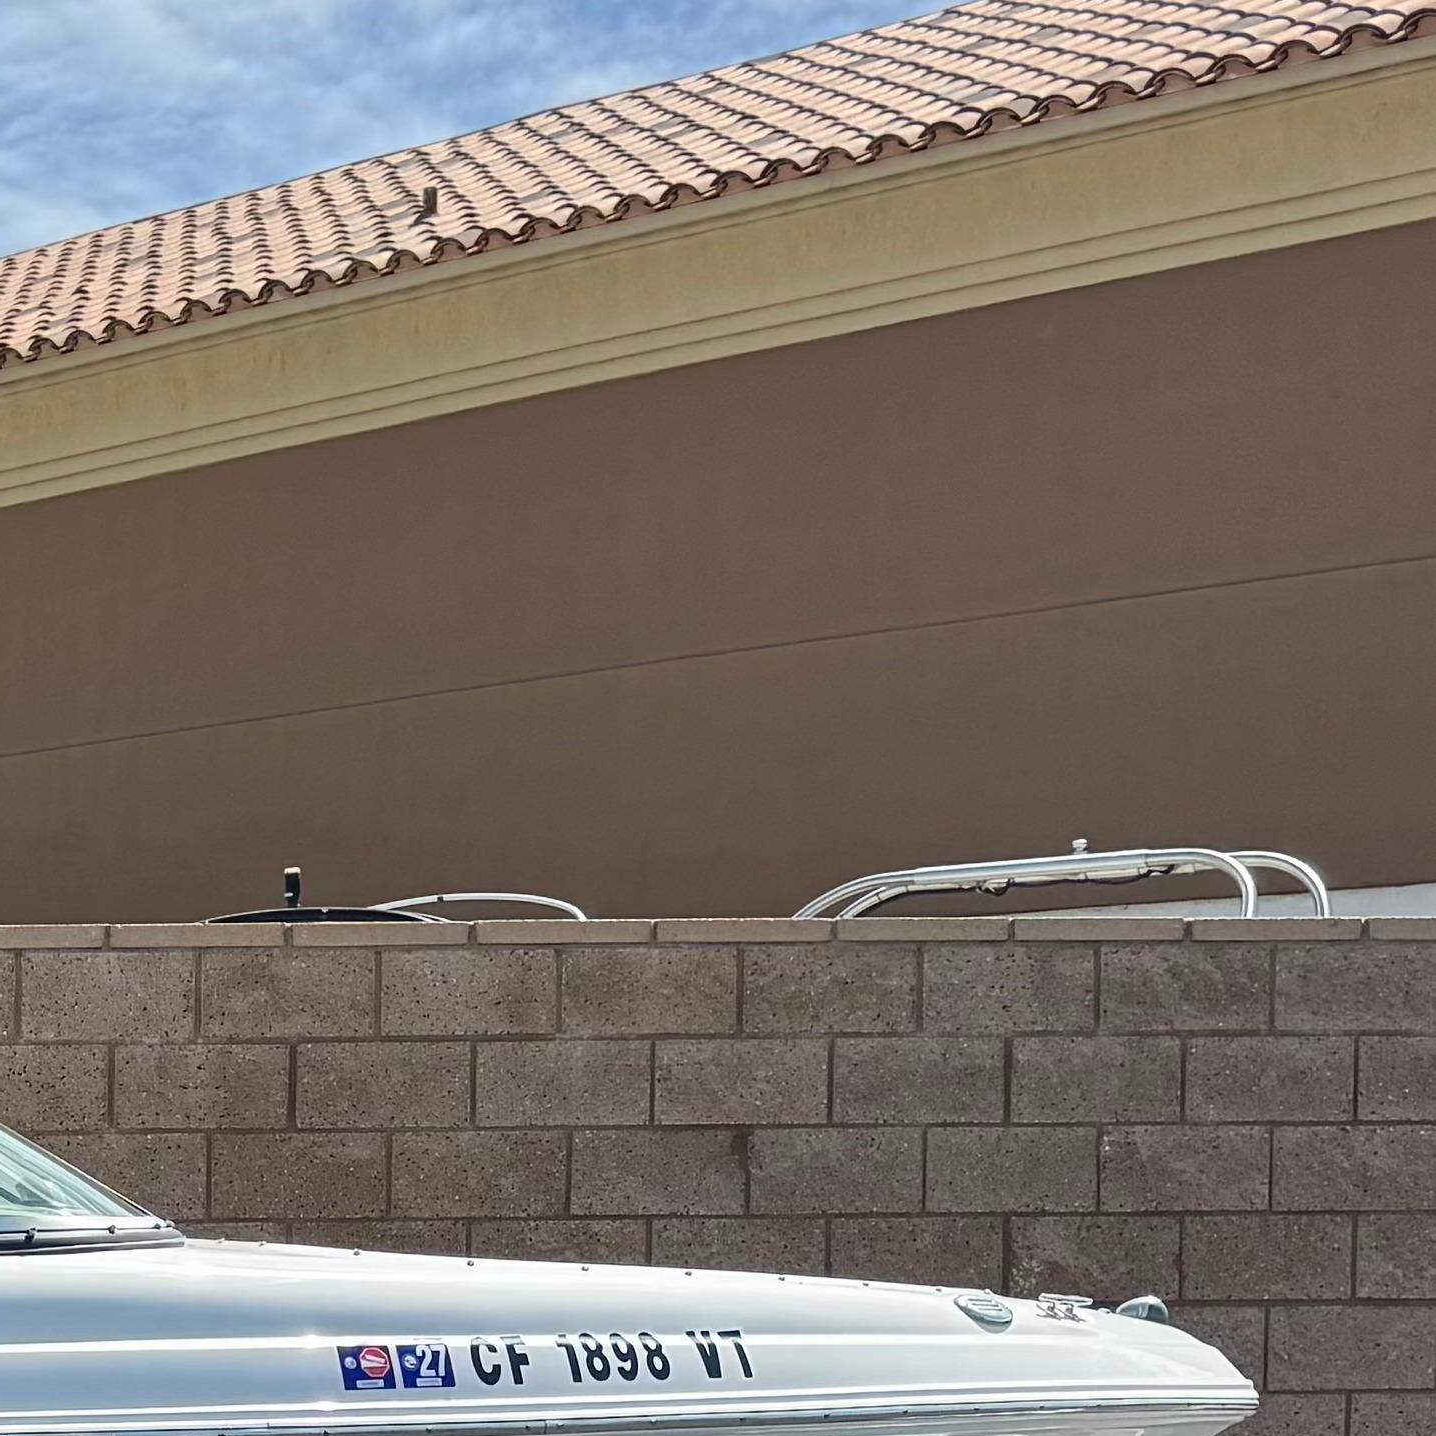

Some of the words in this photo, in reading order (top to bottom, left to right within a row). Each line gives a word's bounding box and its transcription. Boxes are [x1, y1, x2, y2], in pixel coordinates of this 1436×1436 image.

[415, 1343, 447, 1377] 27
[470, 1336, 529, 1385] CF
[556, 1332, 670, 1382] 1898
[685, 1330, 753, 1378] VT
